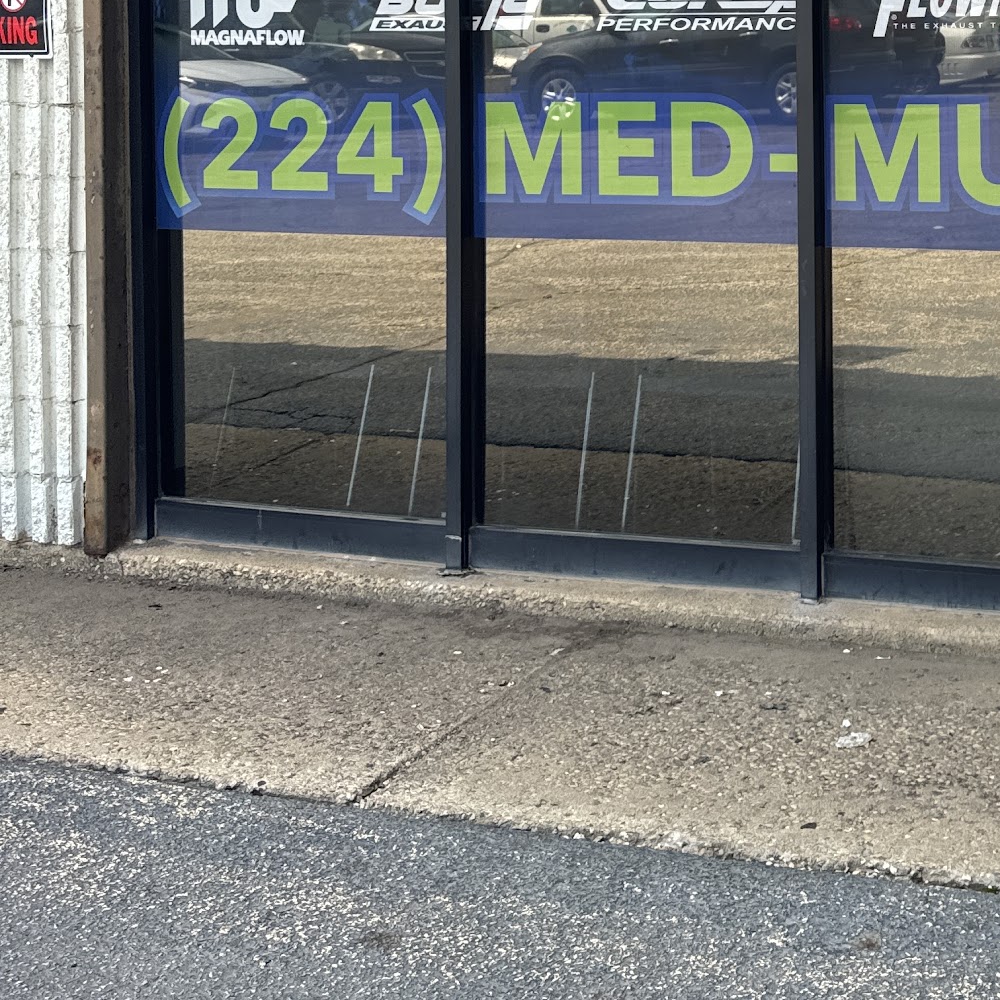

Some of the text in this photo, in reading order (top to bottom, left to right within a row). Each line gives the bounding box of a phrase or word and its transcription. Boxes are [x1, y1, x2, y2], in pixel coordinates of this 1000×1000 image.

[596, 16, 797, 32] PERFORMANC
[893, 22, 917, 30] THE
[923, 21, 984, 30] EXHAUST
[190, 29, 305, 46] MAGNAFLOW
[164, 96, 443, 215] (224)
